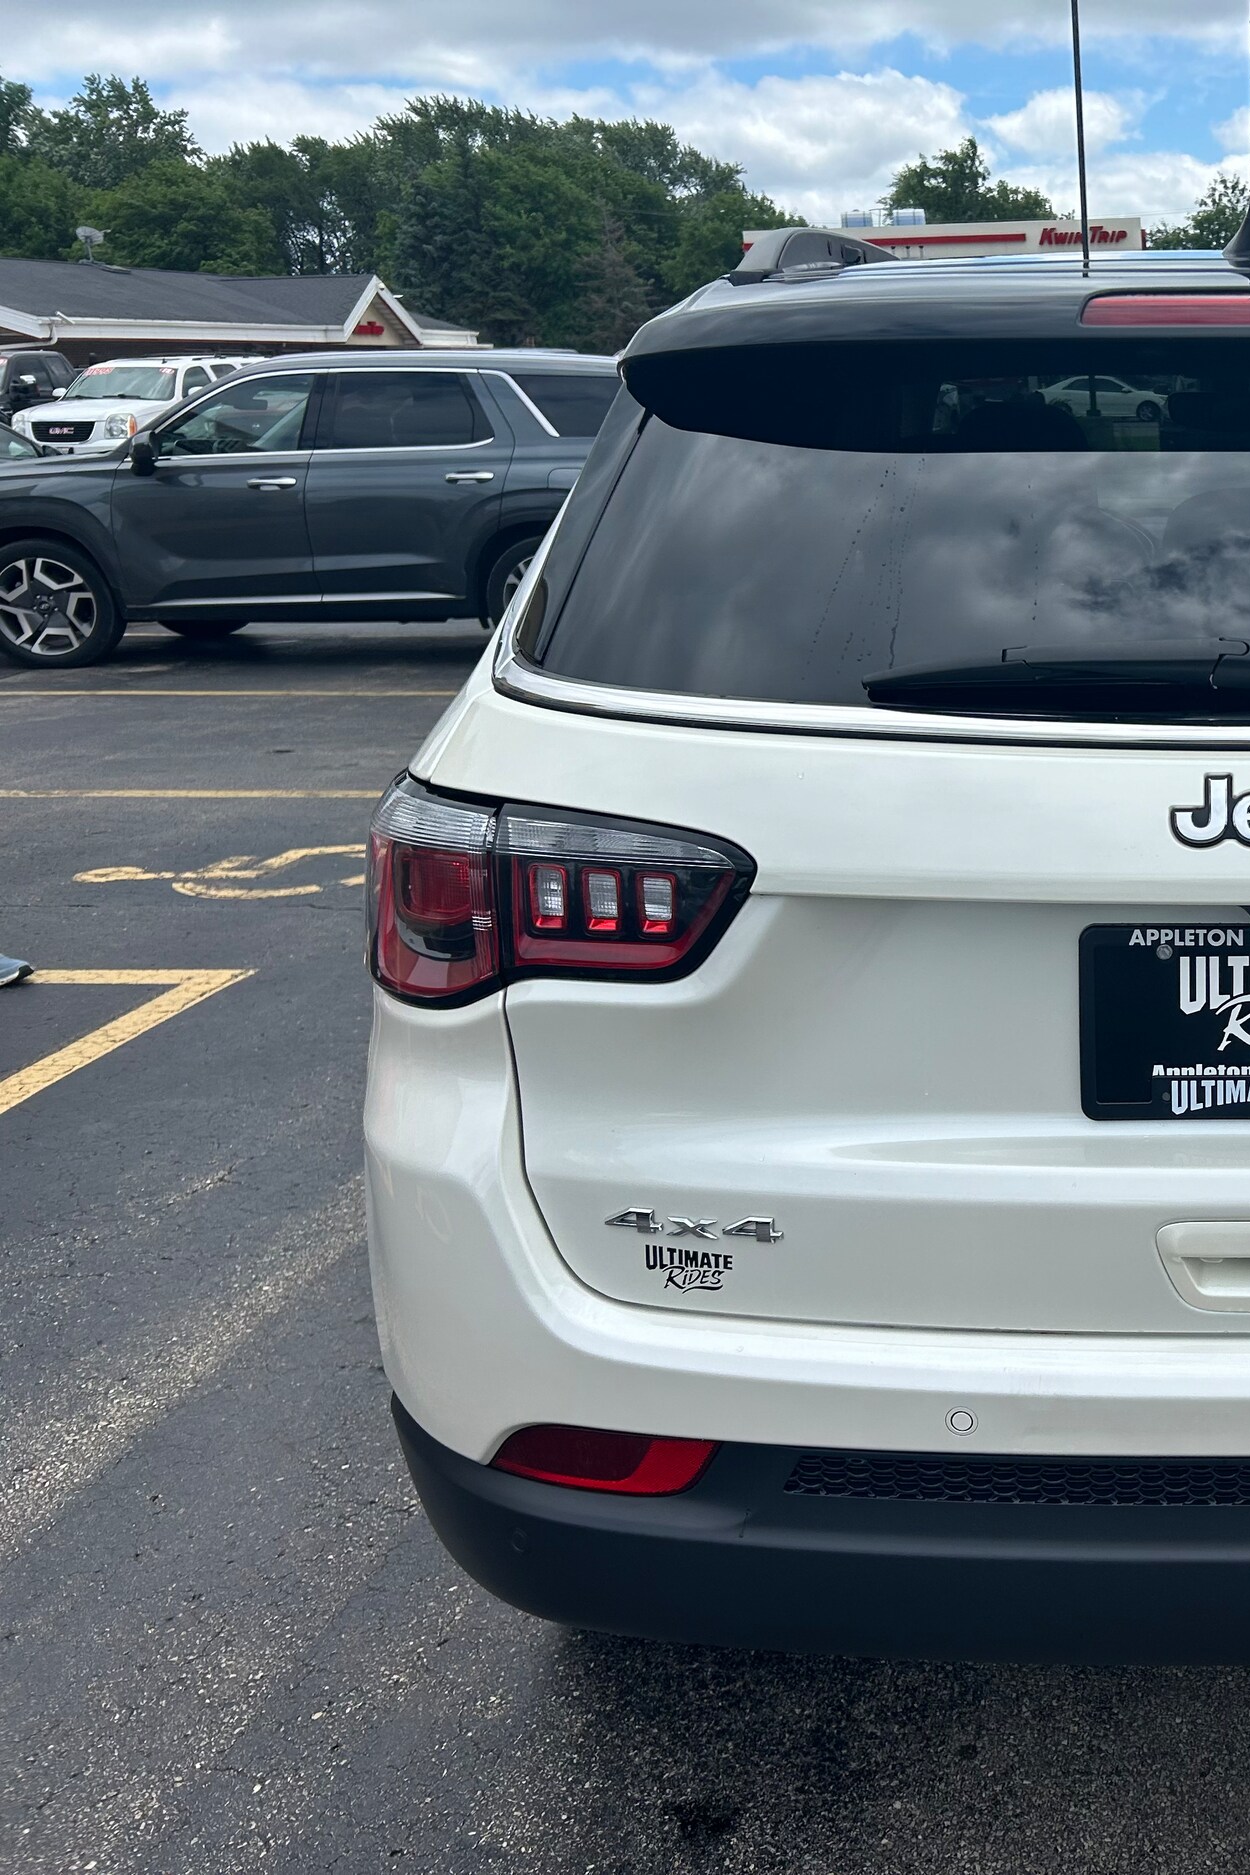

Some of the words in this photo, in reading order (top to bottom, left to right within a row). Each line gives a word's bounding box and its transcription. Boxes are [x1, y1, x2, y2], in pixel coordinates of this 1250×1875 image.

[1089, 226, 1128, 243] TRIP
[1129, 929, 1244, 946] APPLETON
[645, 1244, 733, 1271] ULTIMATE
